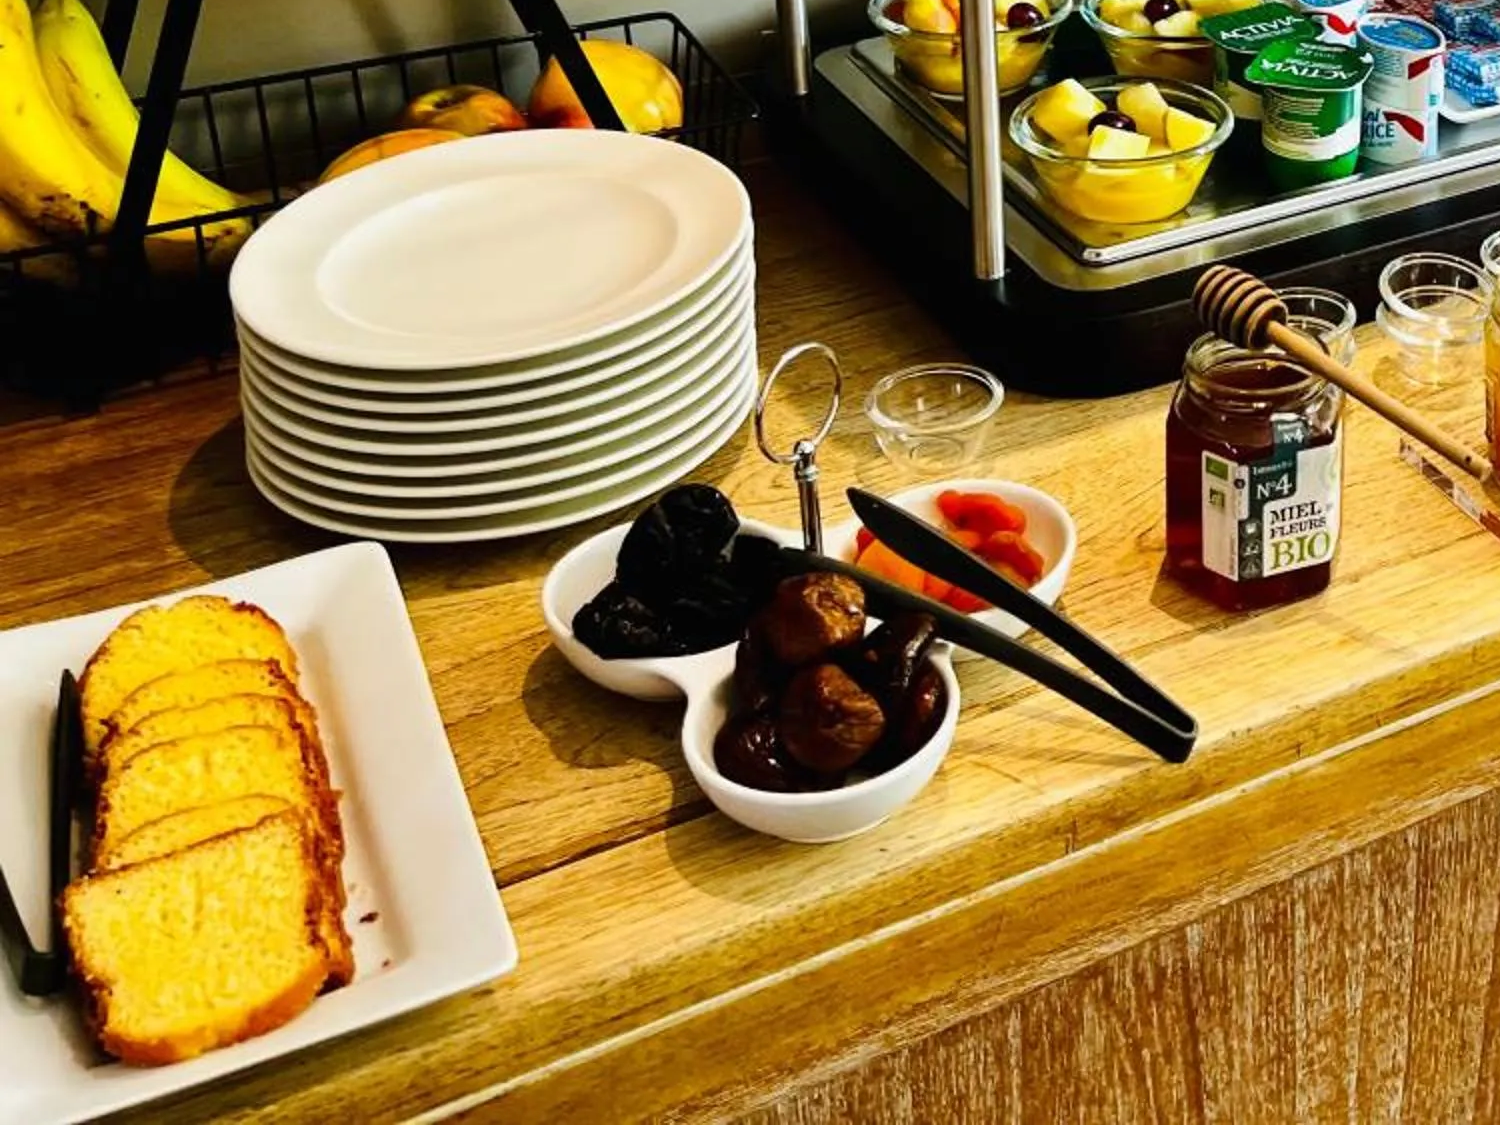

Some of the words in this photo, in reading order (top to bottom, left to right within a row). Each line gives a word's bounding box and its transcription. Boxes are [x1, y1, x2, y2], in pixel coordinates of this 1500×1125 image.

[1219, 15, 1306, 42] ACTIVIA
[1260, 58, 1360, 81] ACTIVIA
[1269, 500, 1323, 525] MIEL
[1269, 517, 1327, 540] FLEURS
[1270, 531, 1332, 570] BIO
